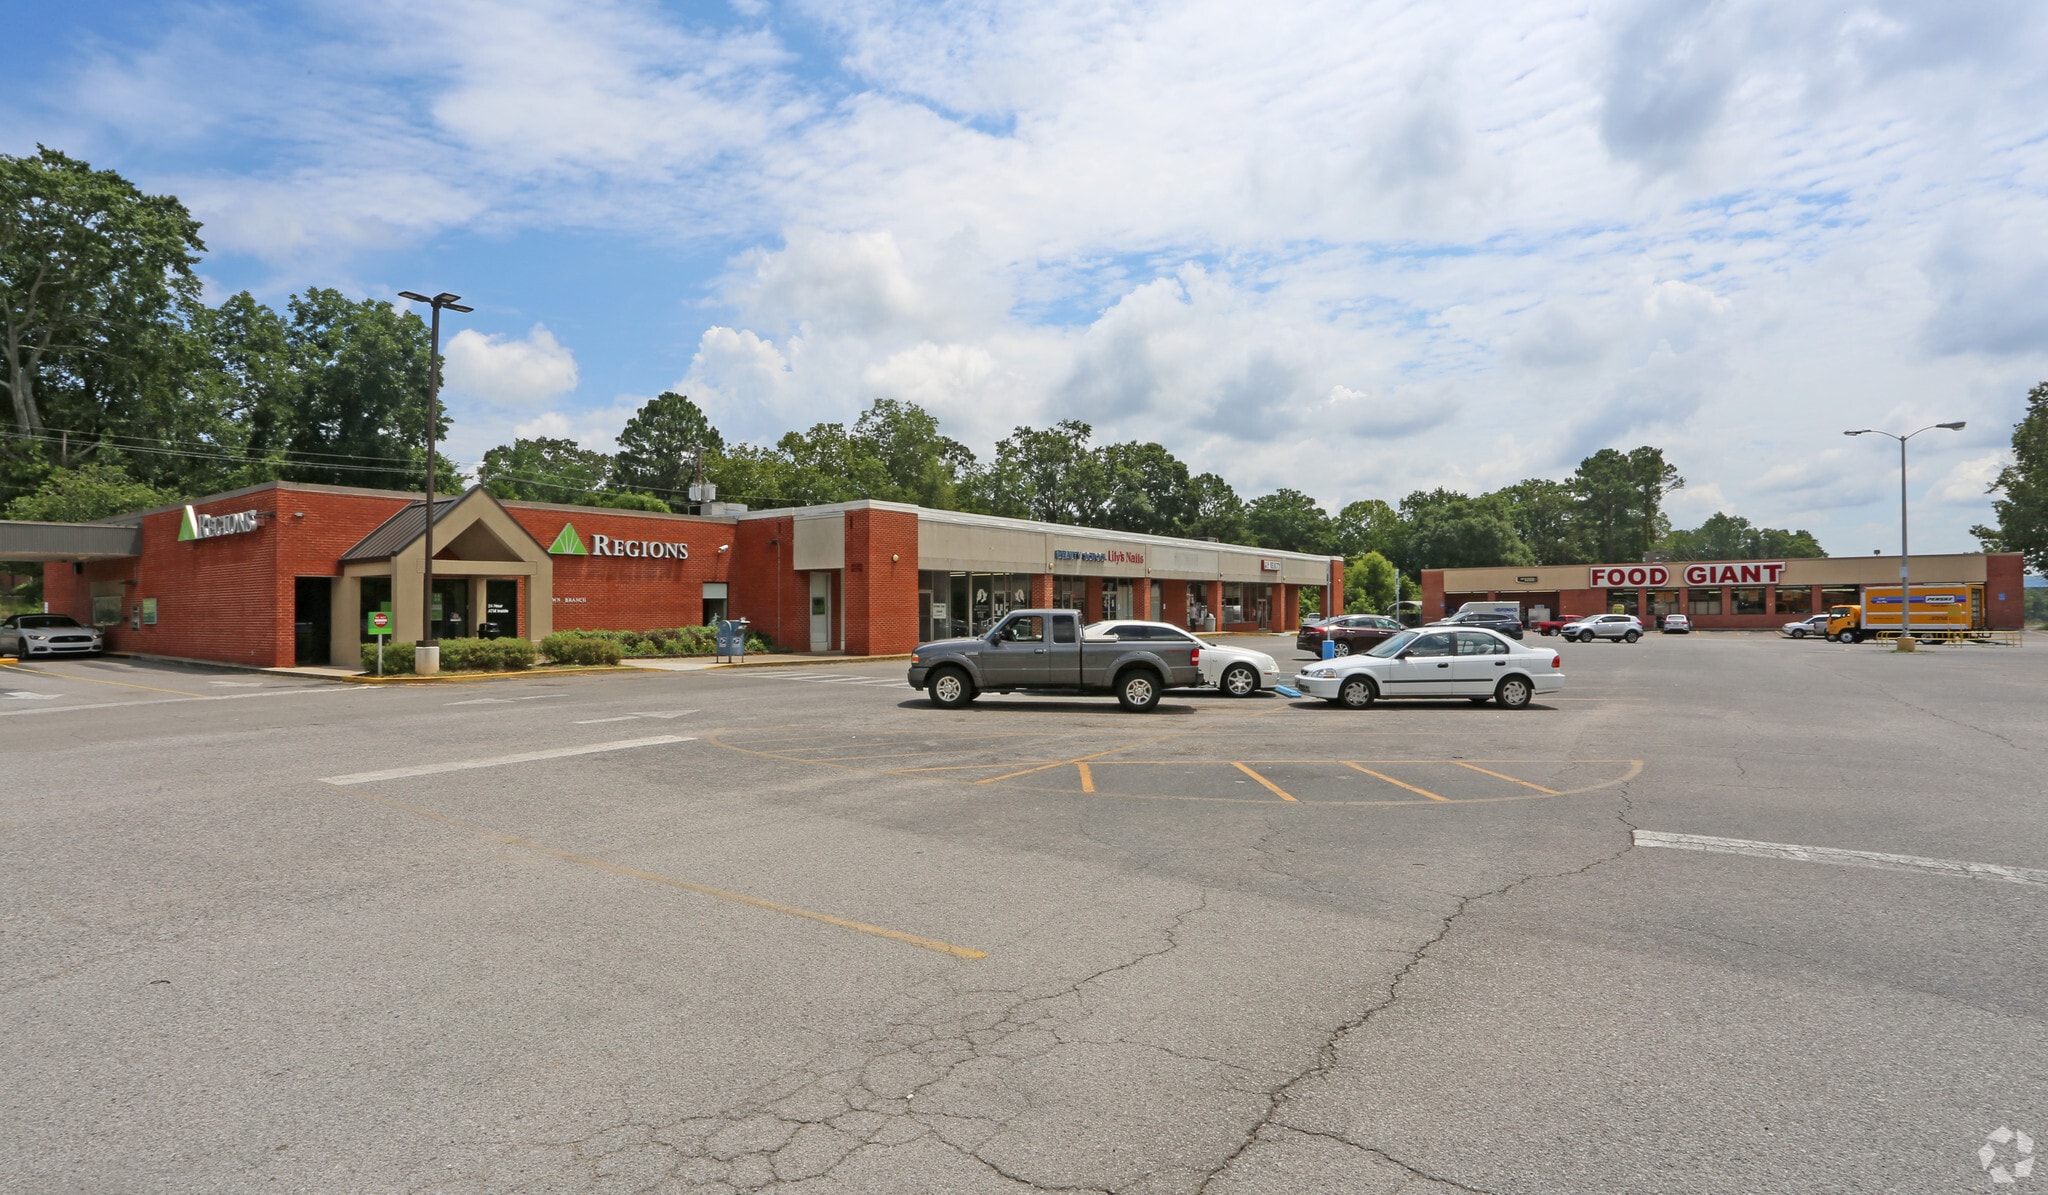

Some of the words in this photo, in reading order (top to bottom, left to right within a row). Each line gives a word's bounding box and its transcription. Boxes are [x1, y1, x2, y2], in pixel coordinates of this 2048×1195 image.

[197, 509, 257, 538] REGIONS
[592, 534, 689, 560] REGIONS
[1108, 550, 1124, 565] Lily's
[1126, 552, 1144, 564] Nails
[1591, 567, 1668, 586] FOOD
[1686, 564, 1783, 585] GIANT
